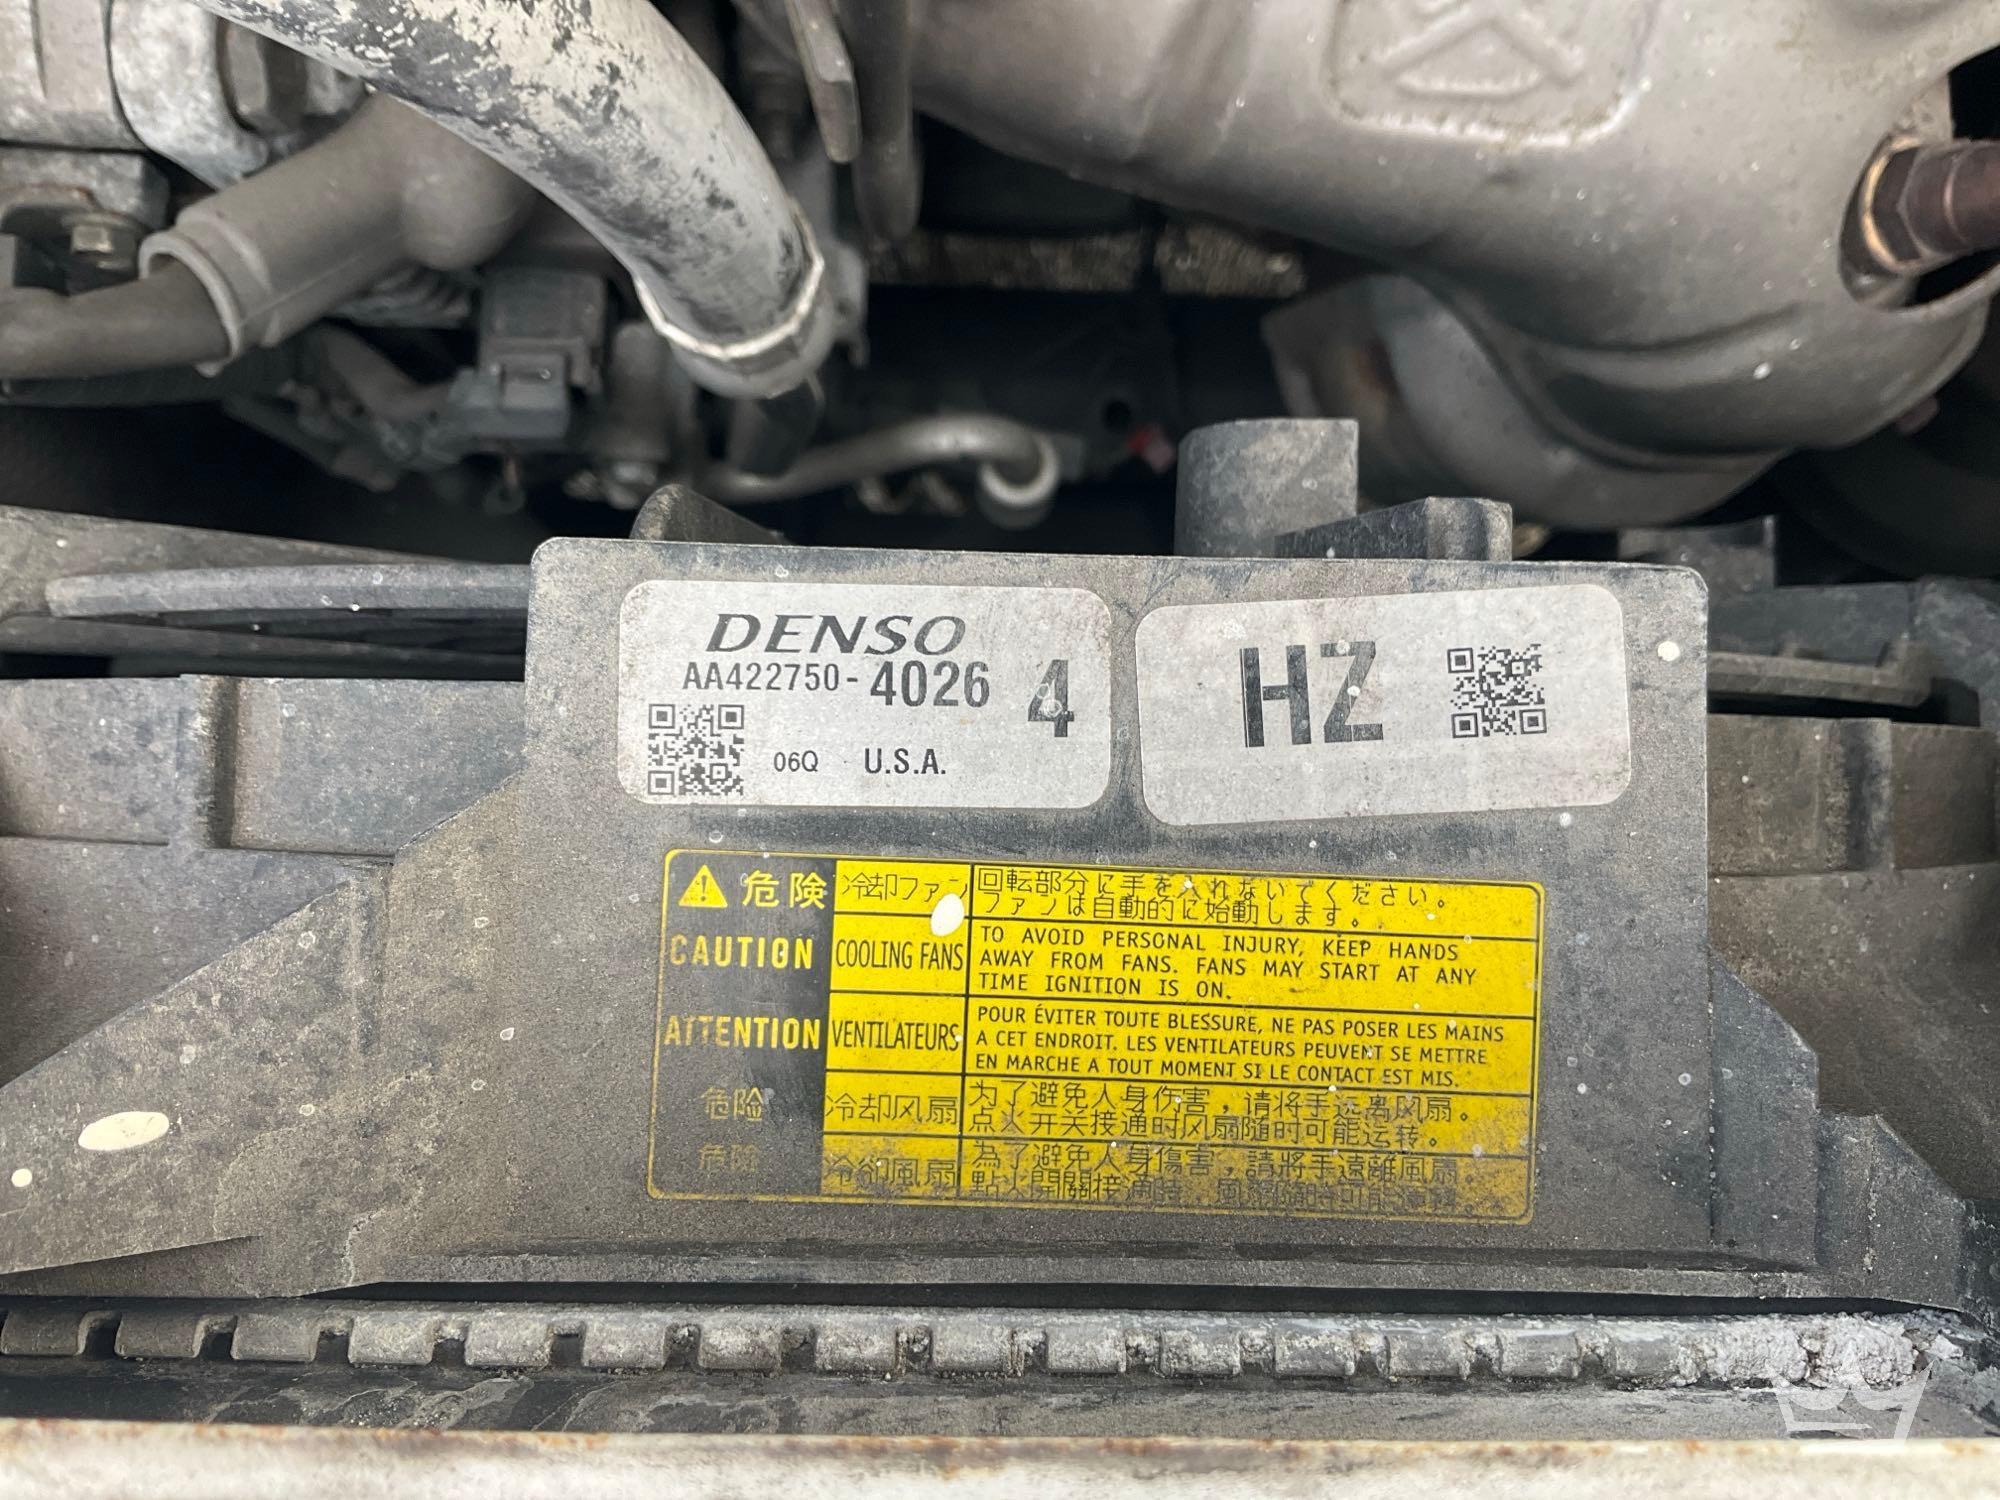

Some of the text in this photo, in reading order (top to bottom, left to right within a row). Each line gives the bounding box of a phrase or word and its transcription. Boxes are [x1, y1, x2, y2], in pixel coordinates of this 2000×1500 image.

[705, 613, 967, 657] DENSO
[1027, 659, 1076, 738] 4
[1240, 640, 1385, 749] HZ
[773, 748, 947, 775] 06Q U.S.A.
[669, 933, 814, 970] CAUTION
[836, 938, 964, 971] COOLING FANS
[980, 925, 1459, 961] TO AVOID PERSONAL INJURY, KEEP HANDS
[979, 950, 1477, 986] AWAY FROM FANS. FANS MAY START AT ANY
[980, 972, 1233, 1000] TIME IGNITION IS ON.
[664, 1014, 821, 1051] ATTENTION
[832, 1019, 961, 1052] VENTILATEURS
[977, 1003, 1505, 1042] POUR ÉVITER TOUTE BLESSURE, NE PAS POSER LES MAINS
[976, 1030, 1488, 1065] A CET ENDROIT. LES VENTILATEURS PEUVENT SE METTRE
[975, 1053, 1460, 1088] EN MARCHE A TOUT MOMENT SI LE CONTACT EST MIS.
[826, 1092, 959, 1126] 冷却风扇
